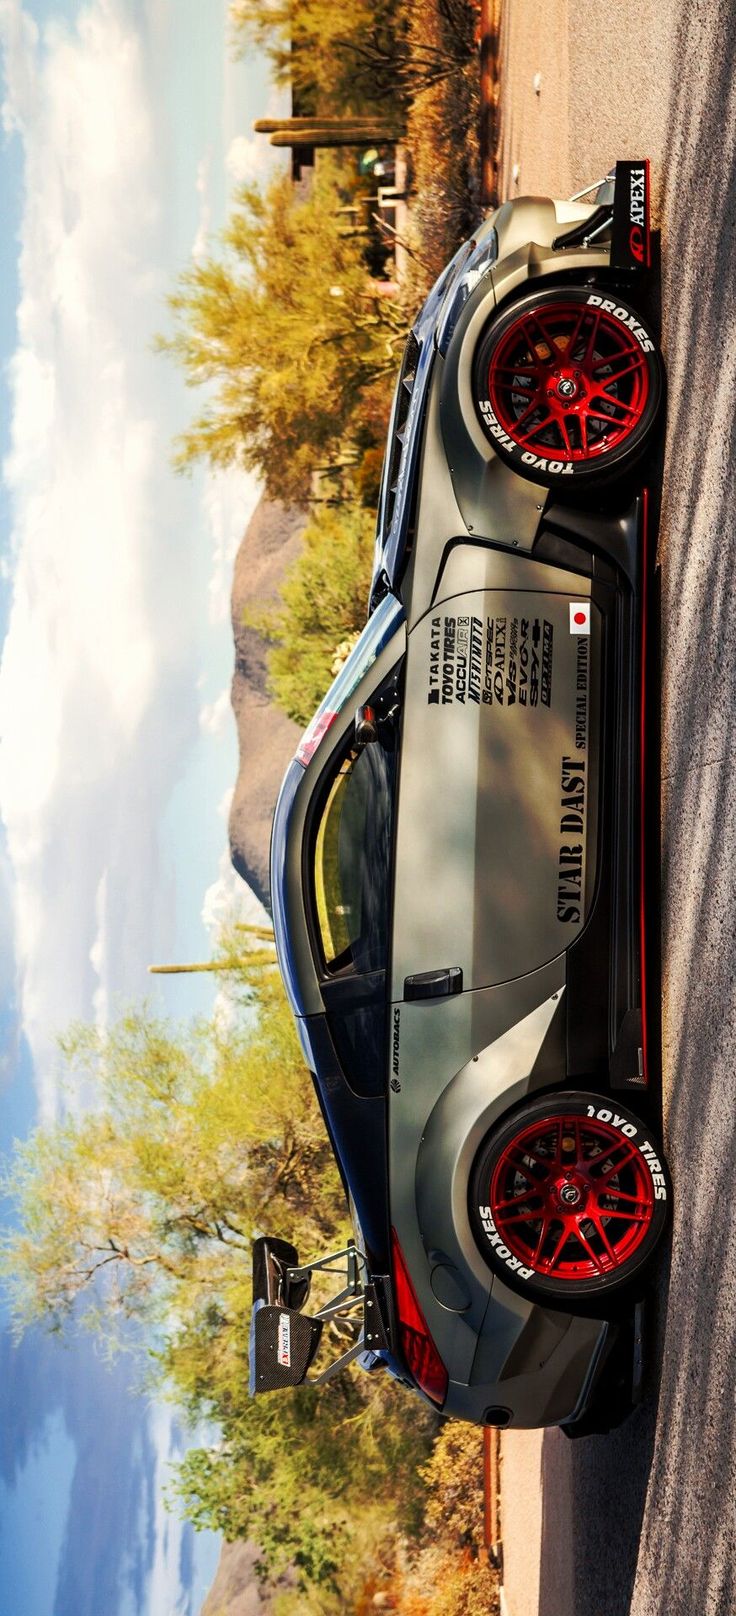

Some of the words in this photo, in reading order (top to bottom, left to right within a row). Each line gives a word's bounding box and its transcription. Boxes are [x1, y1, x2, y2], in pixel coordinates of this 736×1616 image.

[586, 295, 656, 353] PROXES
[478, 400, 517, 452] TIRES
[520, 452, 575, 474] TOYO
[429, 617, 440, 685] TAKATA
[443, 616, 456, 662] TIRES
[468, 617, 483, 704] MISHIMOTO
[485, 617, 494, 691] GTSPEC
[541, 625, 550, 702] OPTIMA
[576, 636, 588, 691] EDITION
[442, 663, 454, 705] TOYO
[575, 694, 587, 749] SPECIAL
[559, 756, 585, 835] DAST
[557, 844, 583, 924] STAR
[586, 1105, 638, 1138] TOYO
[638, 1140, 667, 1201] TIRES
[479, 1206, 535, 1280] PROXES
